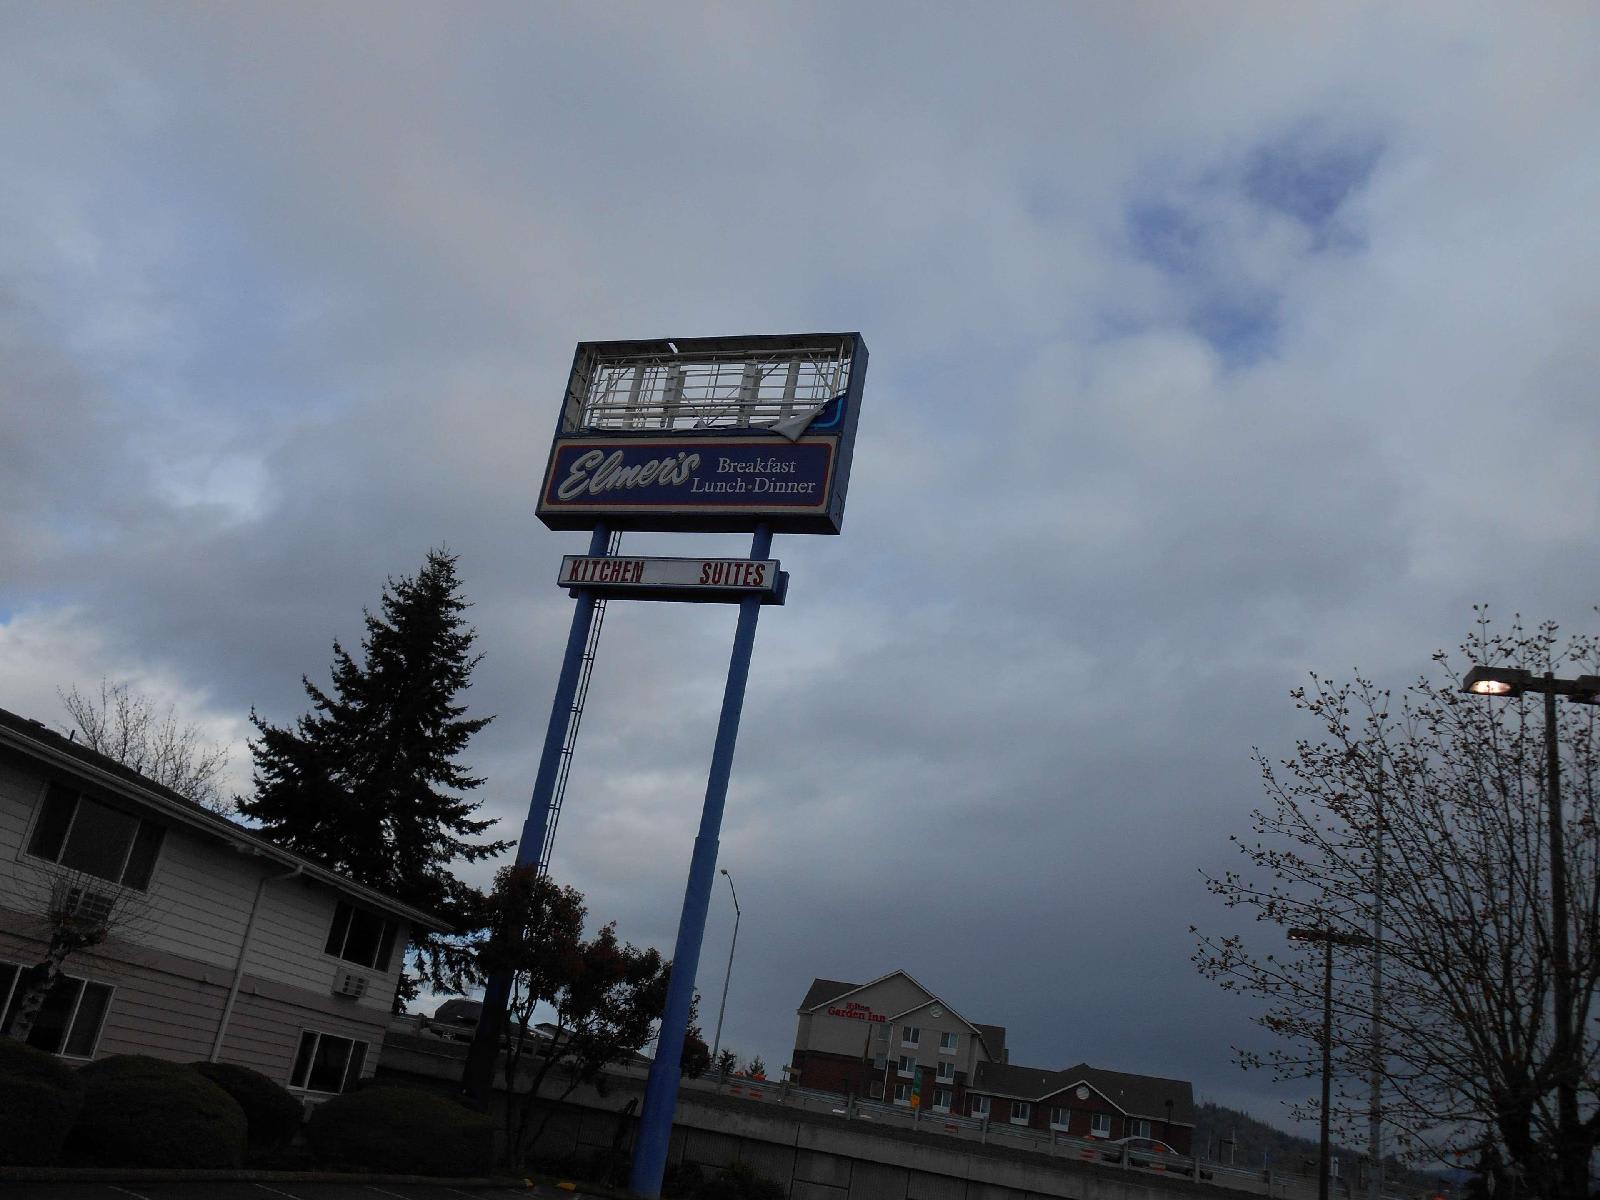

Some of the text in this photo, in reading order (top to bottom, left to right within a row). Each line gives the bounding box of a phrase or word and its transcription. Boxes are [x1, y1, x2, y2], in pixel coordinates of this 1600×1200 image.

[558, 449, 702, 501] Elmer's
[717, 457, 796, 474] Breakfast
[570, 559, 766, 586] KITCHEN SUITES
[828, 1006, 886, 1023] Garden Inn
